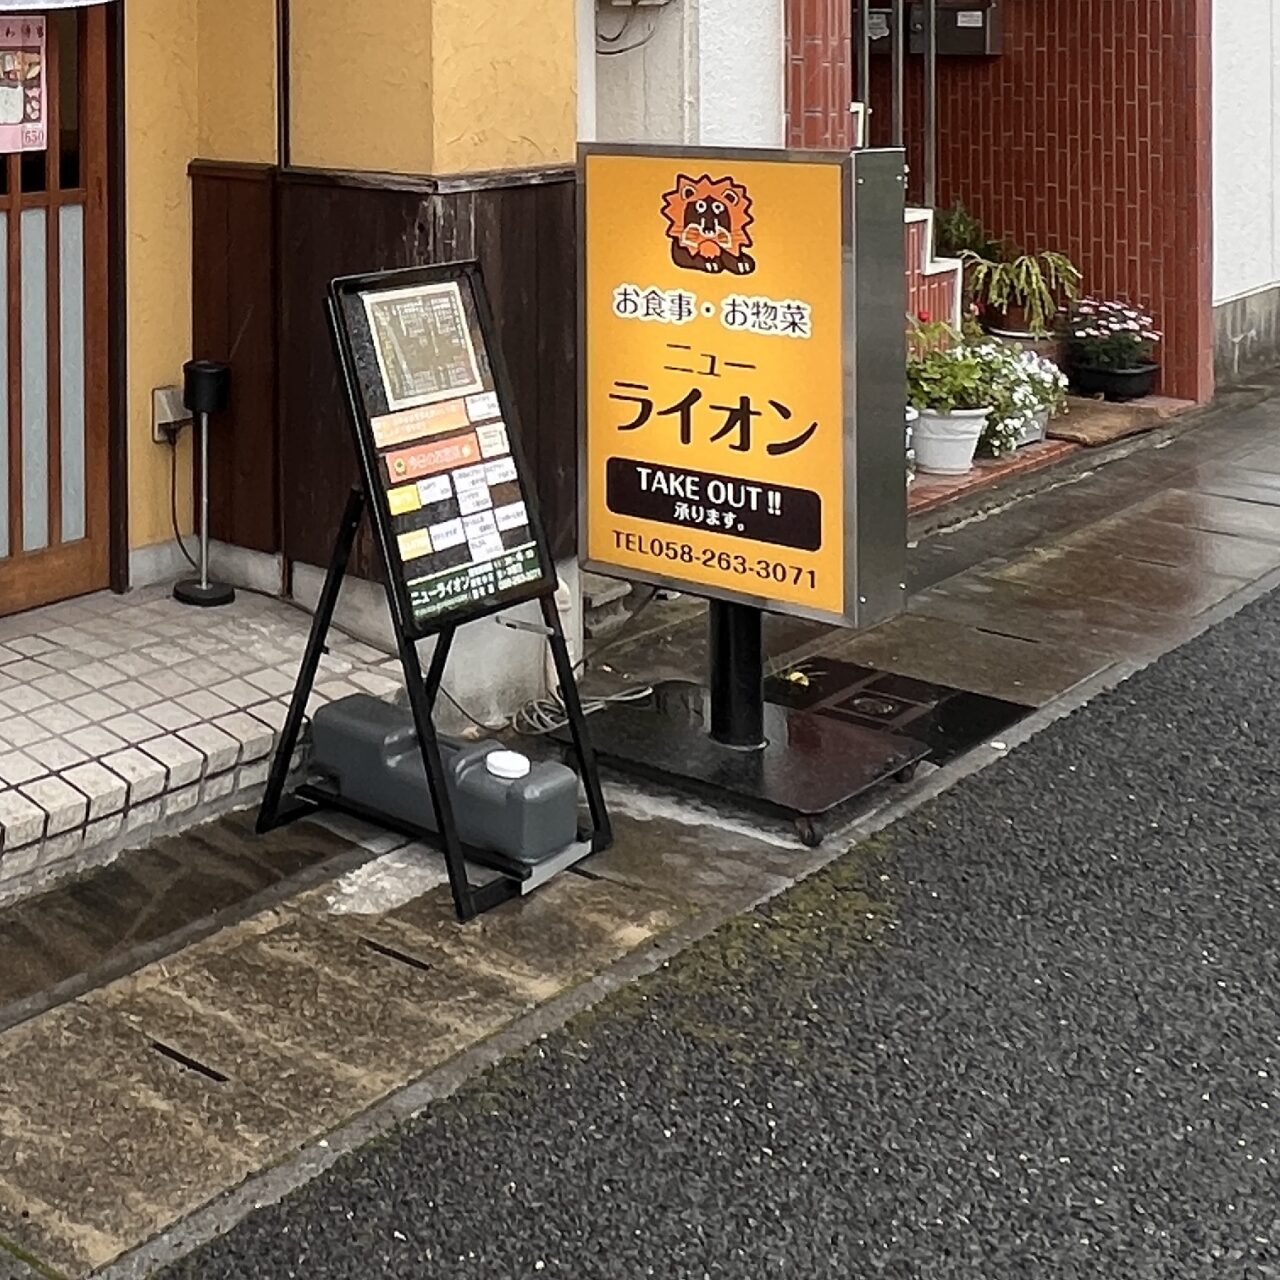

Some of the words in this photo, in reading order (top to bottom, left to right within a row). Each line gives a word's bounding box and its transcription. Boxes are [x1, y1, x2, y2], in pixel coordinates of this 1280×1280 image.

[615, 288, 810, 334] お食事・お惣菜
[663, 343, 757, 378] ニュー
[608, 381, 818, 456] ライオン
[636, 467, 699, 500] TAKE
[673, 502, 745, 531] 承ります。
